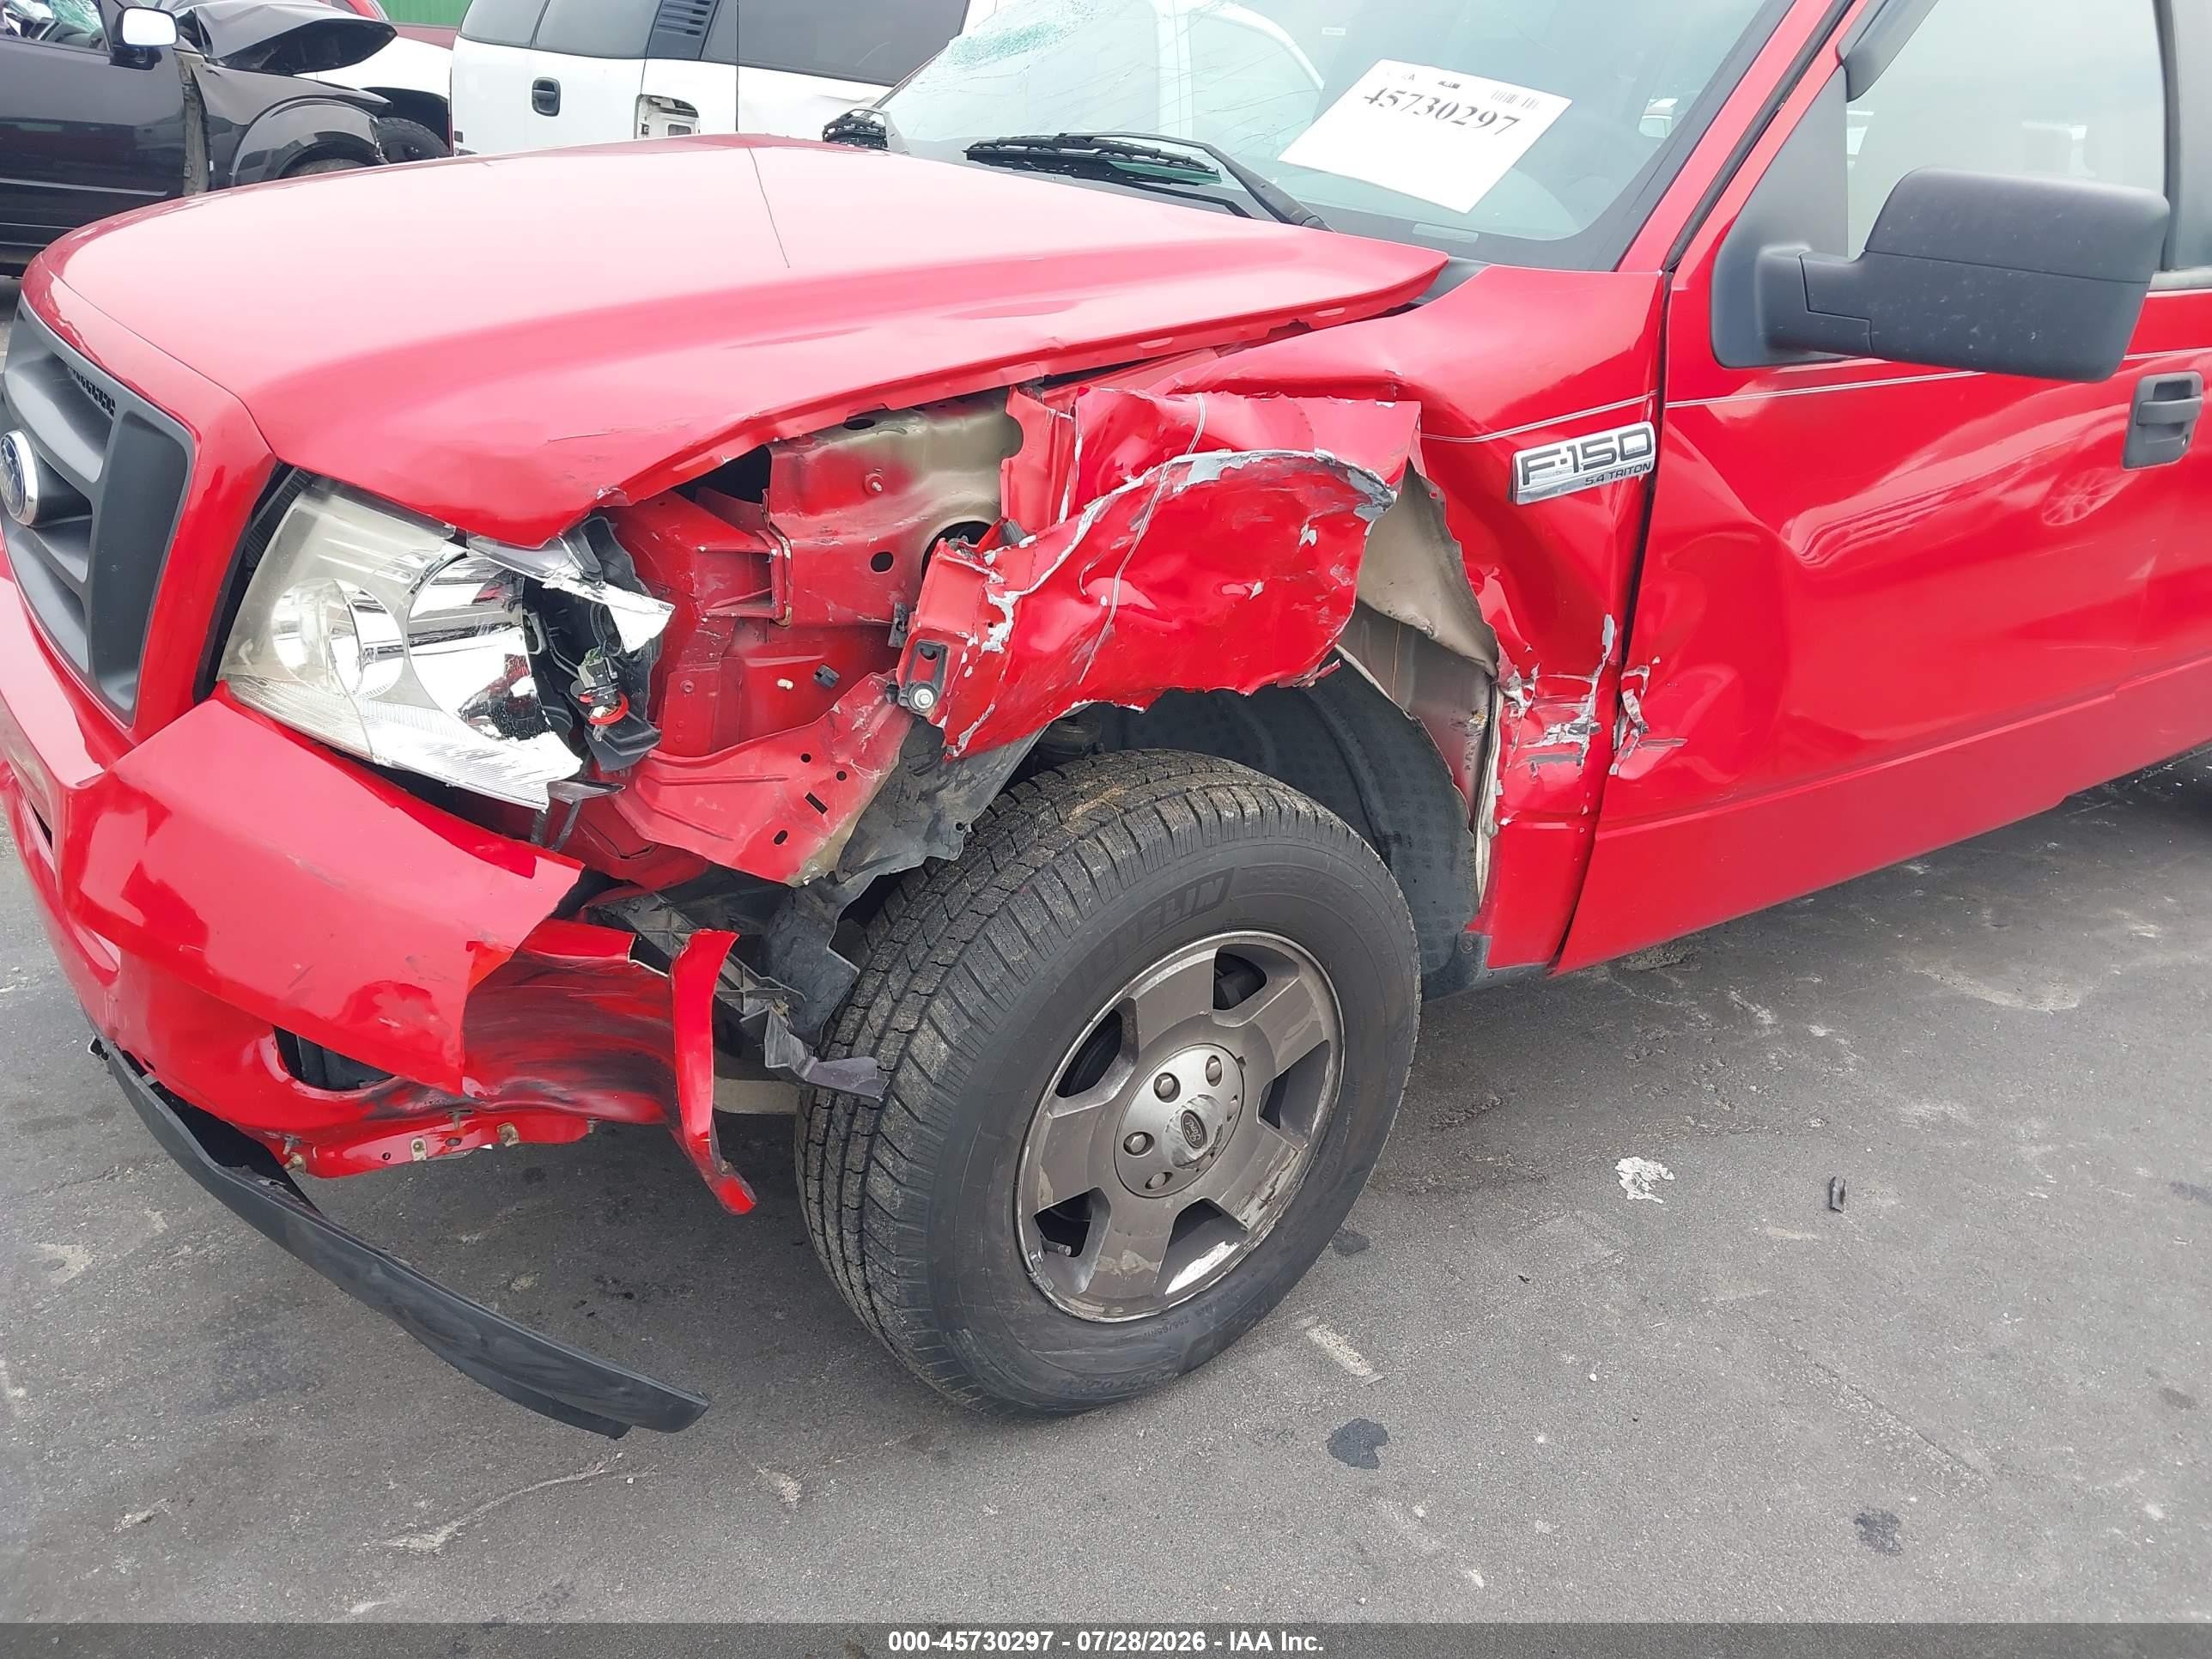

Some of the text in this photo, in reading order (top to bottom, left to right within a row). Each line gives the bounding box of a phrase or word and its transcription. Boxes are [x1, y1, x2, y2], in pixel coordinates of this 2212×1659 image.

[1363, 87, 1521, 136] 45730297
[1521, 427, 1652, 485] F-150
[1608, 461, 1651, 481] TRITON
